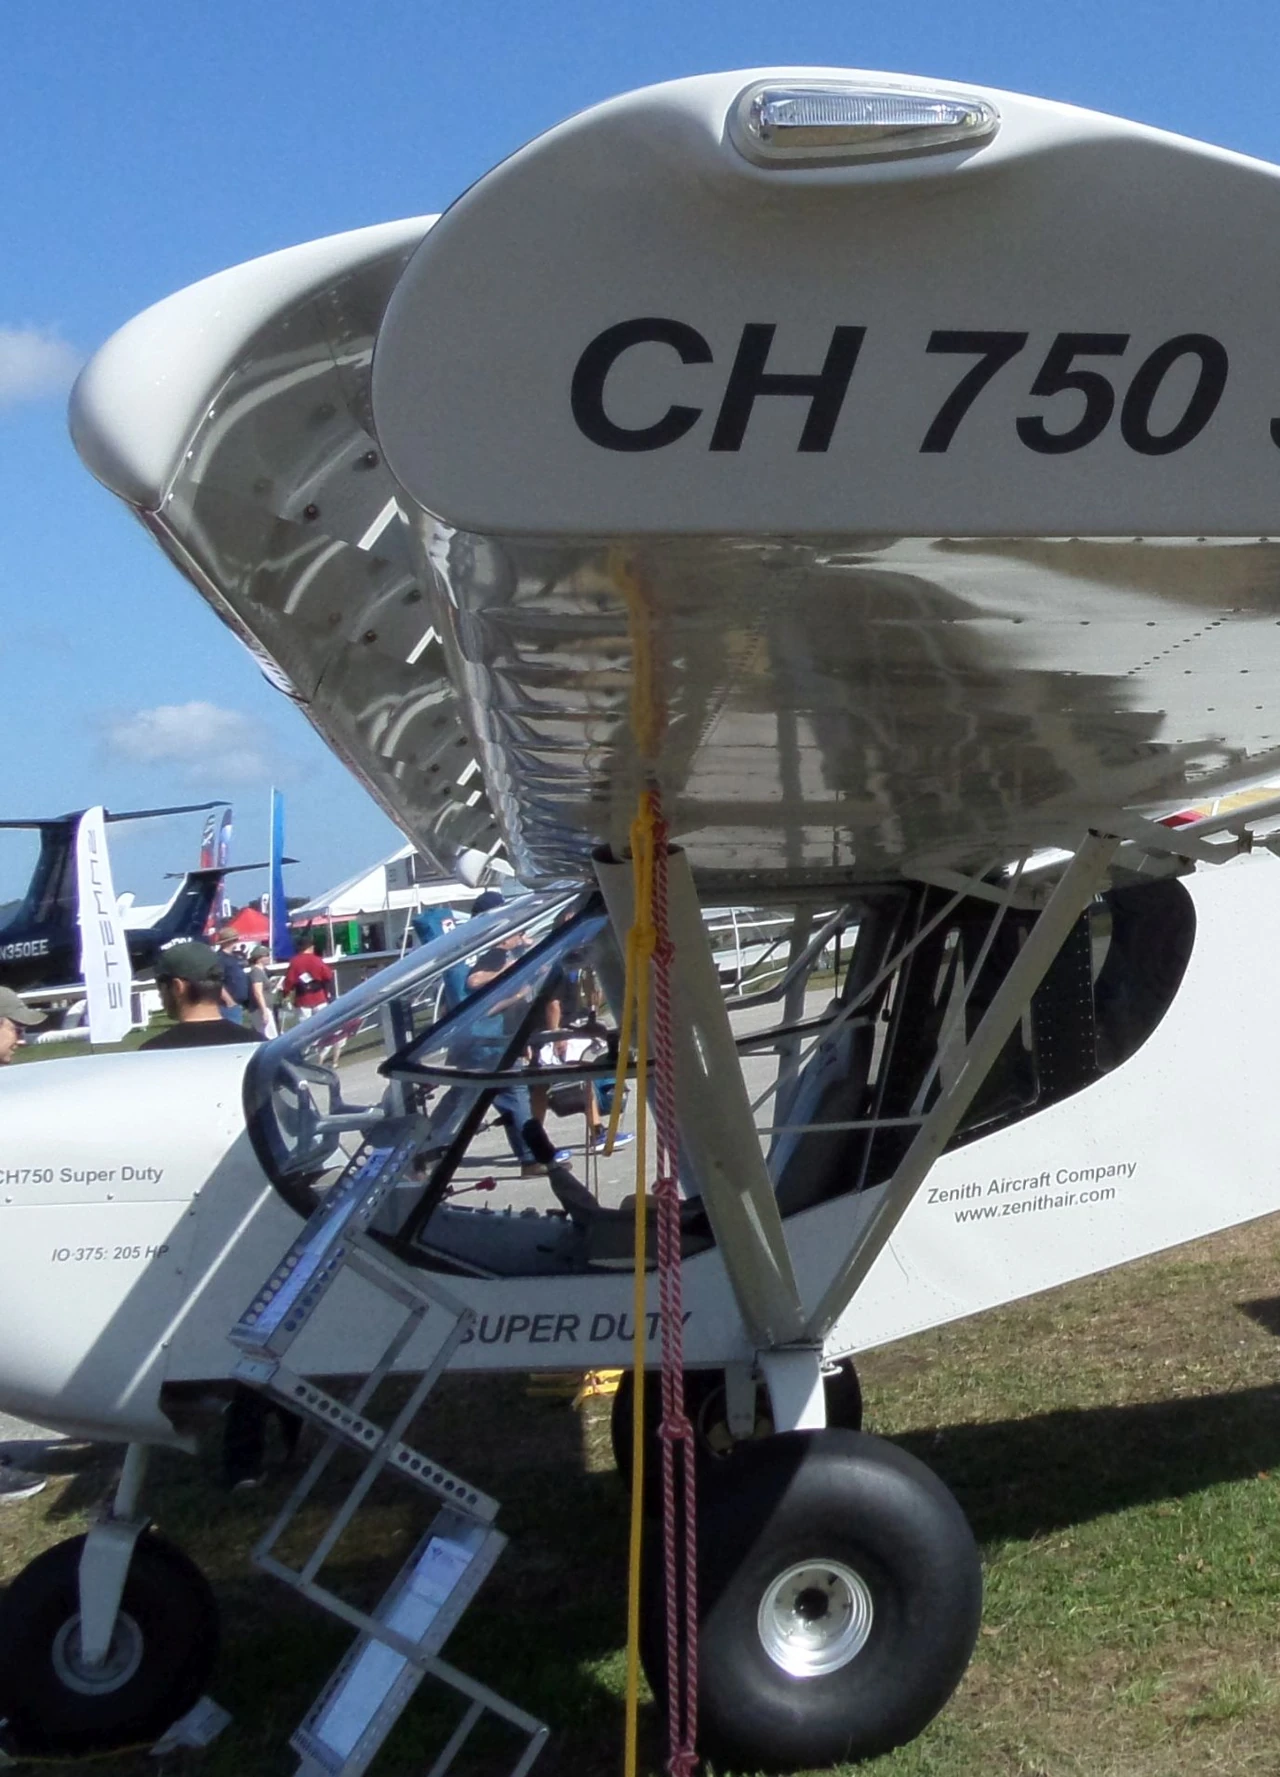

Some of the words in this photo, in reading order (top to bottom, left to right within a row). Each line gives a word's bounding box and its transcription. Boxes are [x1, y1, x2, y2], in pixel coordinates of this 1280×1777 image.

[570, 316, 867, 453] CH
[917, 330, 1230, 456] 750
[60, 1168, 116, 1186] Super
[121, 1166, 163, 1184] Duty
[927, 1183, 982, 1205] Zenith
[987, 1172, 1051, 1196] Aircraft
[1056, 1162, 1137, 1185] Company
[955, 1187, 1116, 1223] www.zenithair.com
[113, 1246, 141, 1260] 205
[145, 1244, 170, 1259] HP
